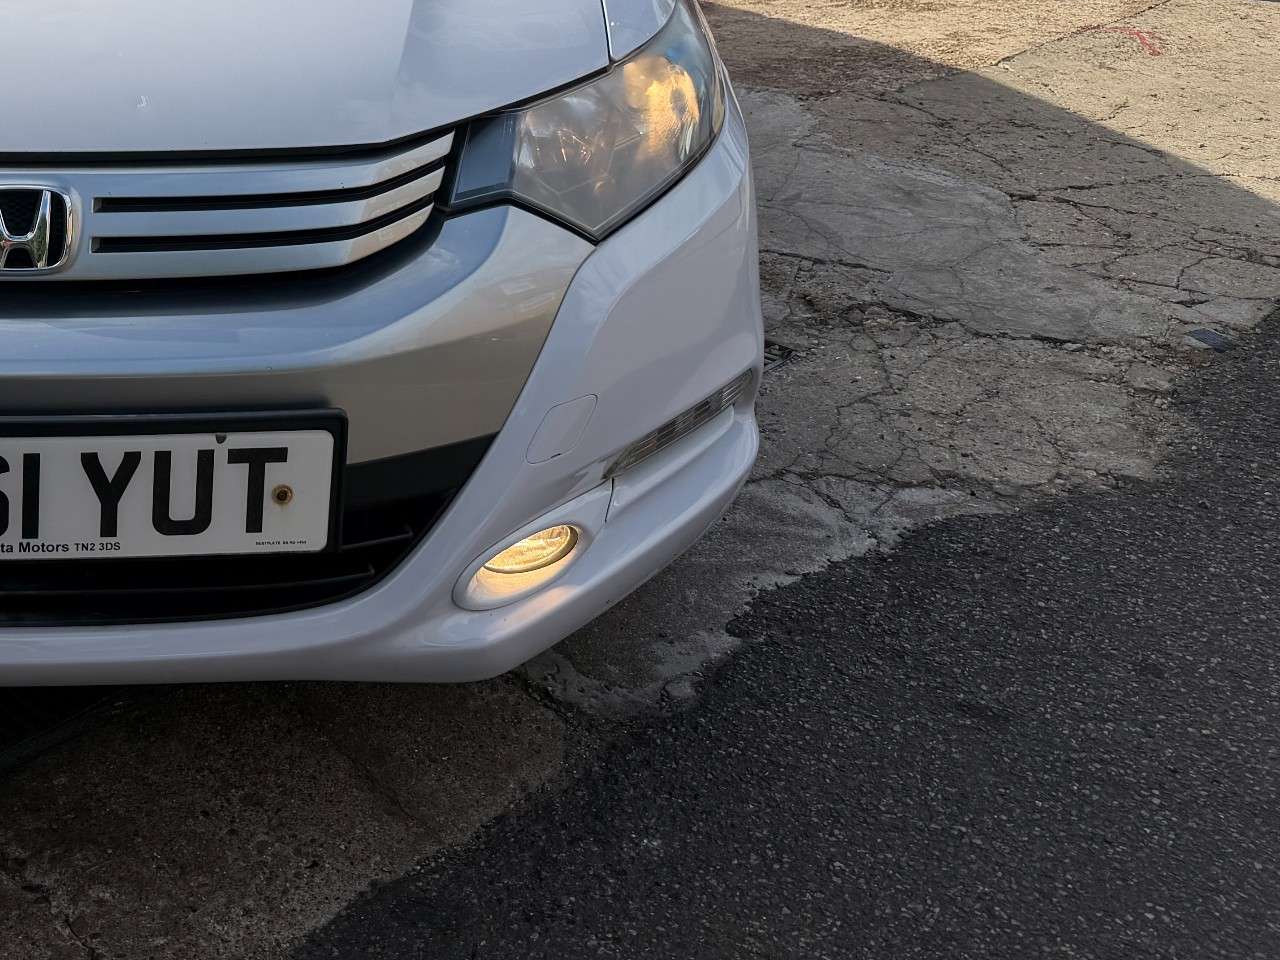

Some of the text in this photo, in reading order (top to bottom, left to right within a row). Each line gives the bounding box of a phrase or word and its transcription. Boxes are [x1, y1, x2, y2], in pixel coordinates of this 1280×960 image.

[80, 446, 289, 537] YUT
[19, 542, 70, 553] Motors
[74, 542, 96, 552] TN2
[99, 542, 121, 551] 3DS
